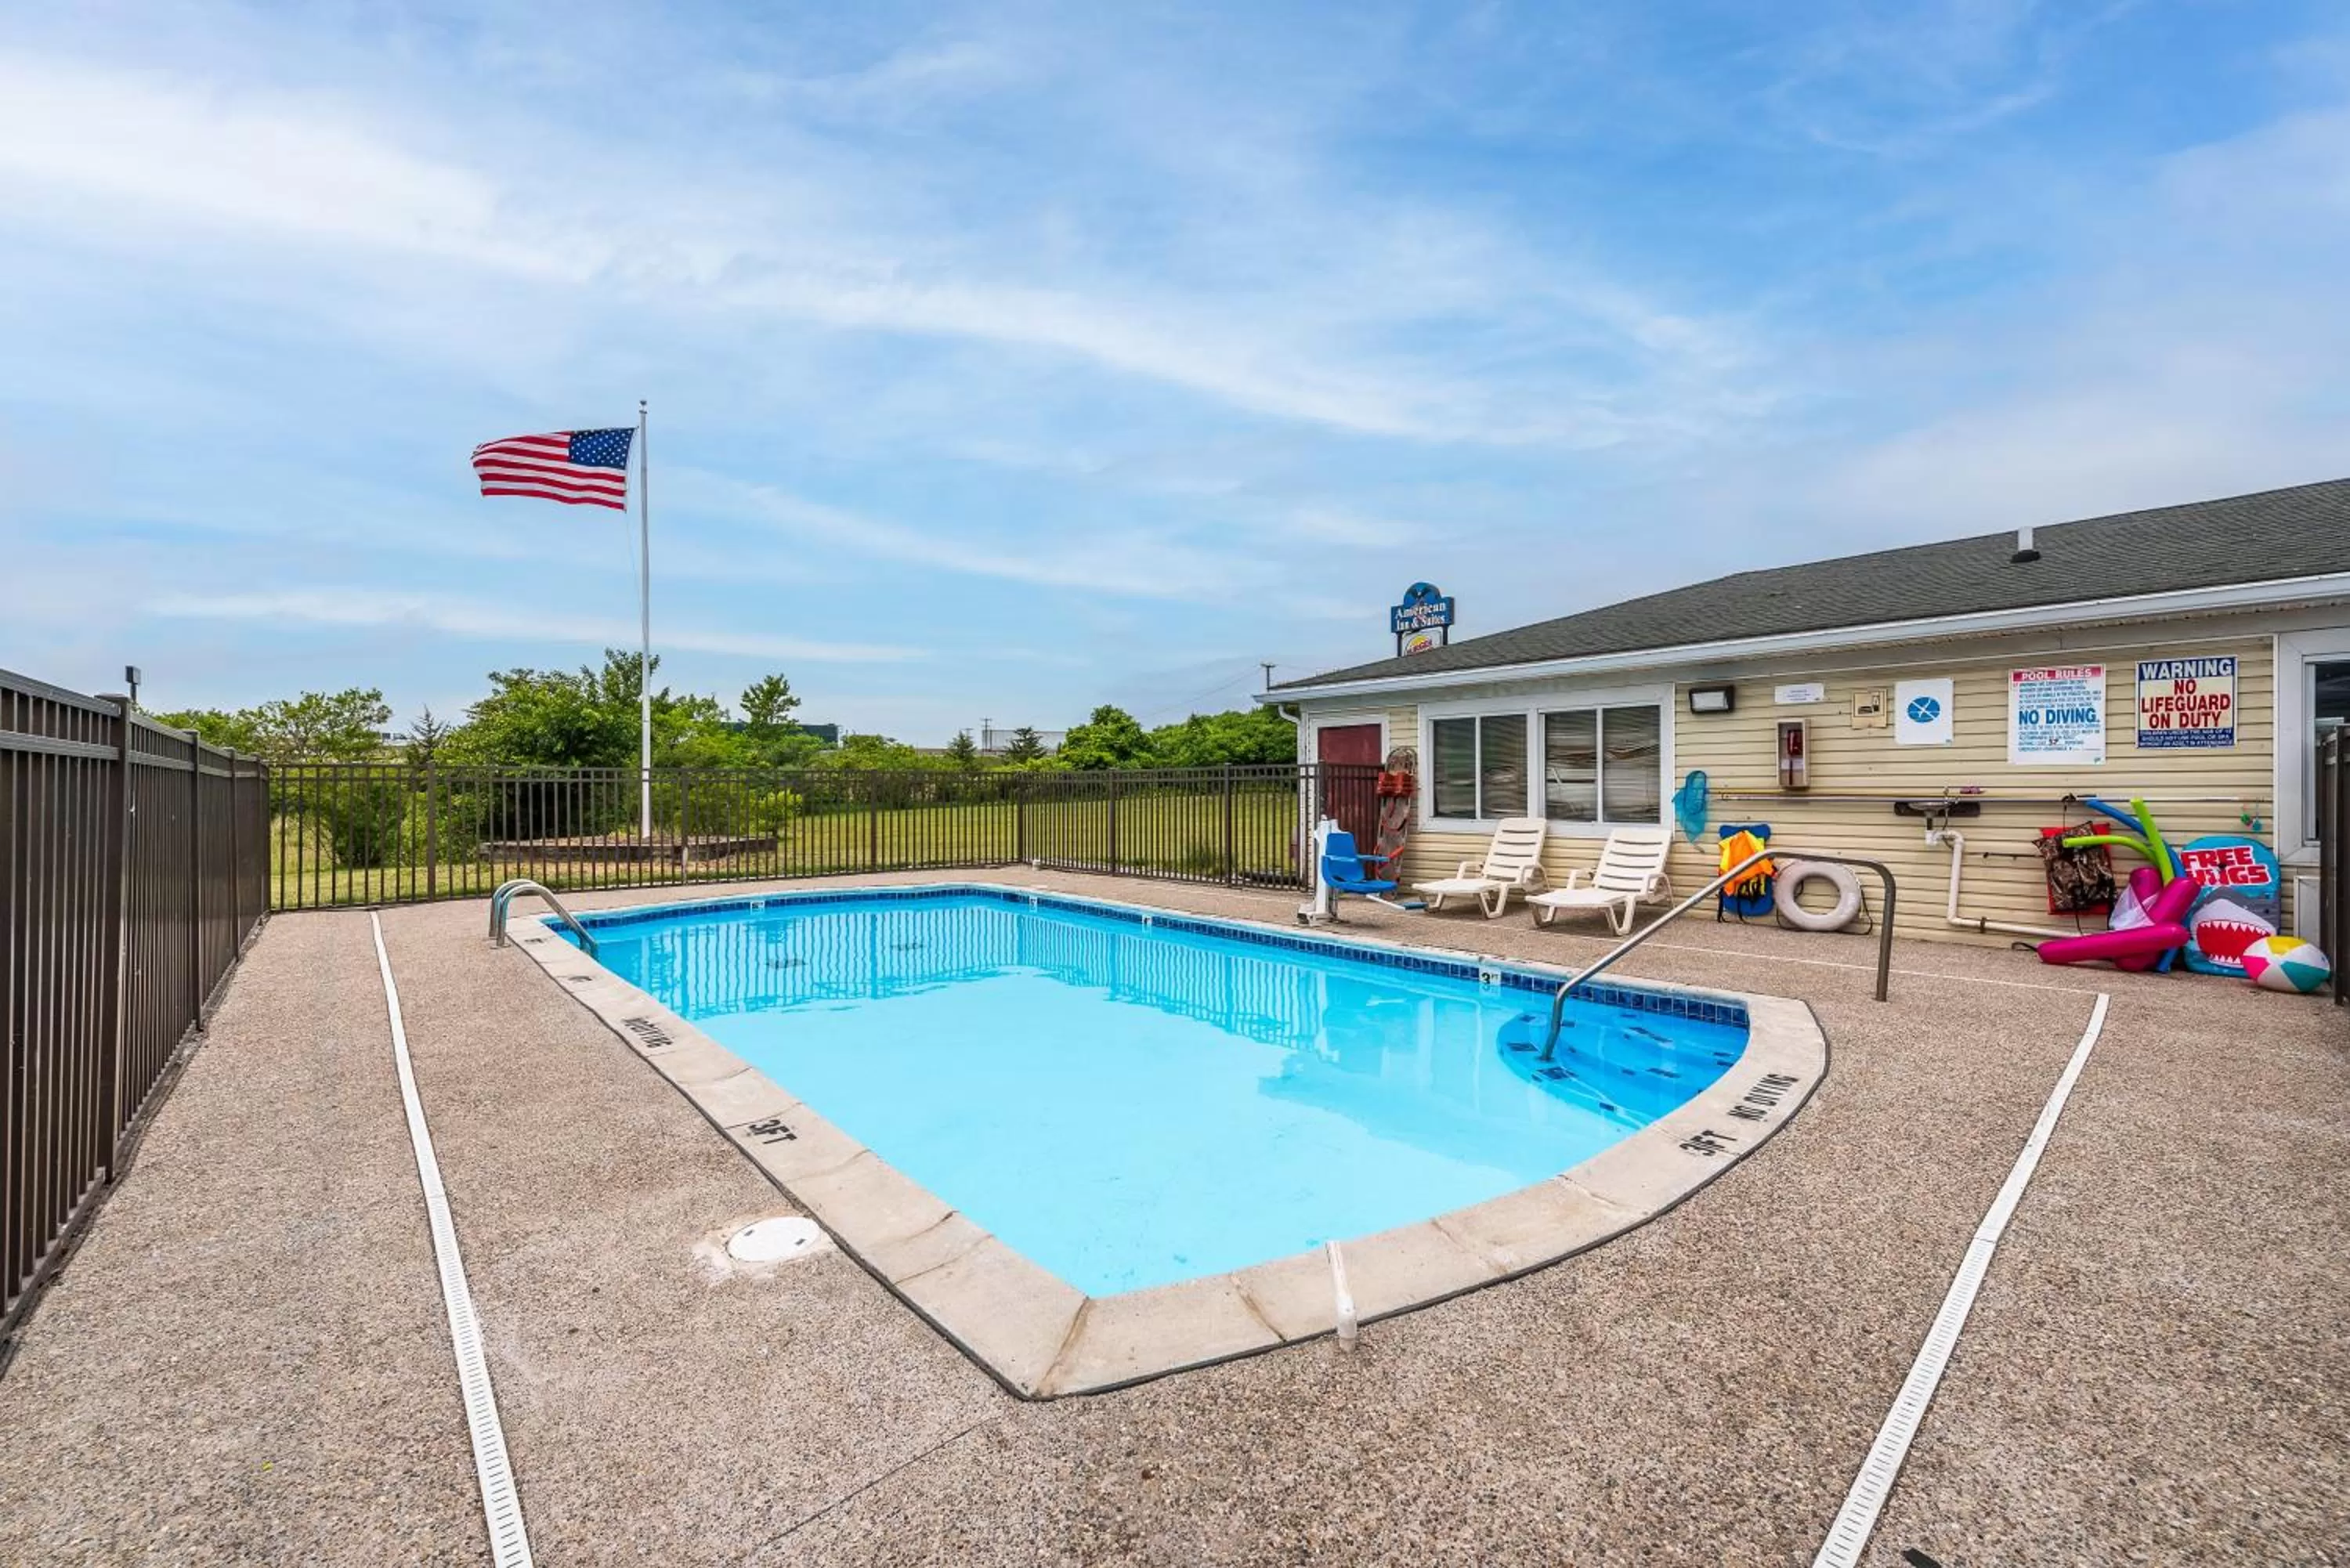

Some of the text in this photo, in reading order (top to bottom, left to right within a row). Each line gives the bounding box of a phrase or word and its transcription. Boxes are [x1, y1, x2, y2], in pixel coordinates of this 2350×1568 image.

[2022, 668, 2092, 681] POOL RULES
[2142, 659, 2232, 680] WARNING
[2174, 679, 2197, 695] NO
[2141, 693, 2231, 713] LIFEGUARD
[2019, 707, 2101, 724] NO DIVING.
[2149, 711, 2222, 729] ON DUTY
[2181, 847, 2254, 869] FREE
[1743, 1074, 1799, 1107] DIVING
[747, 1119, 797, 1144] 3FT
[1679, 1129, 1738, 1157] 3FT
